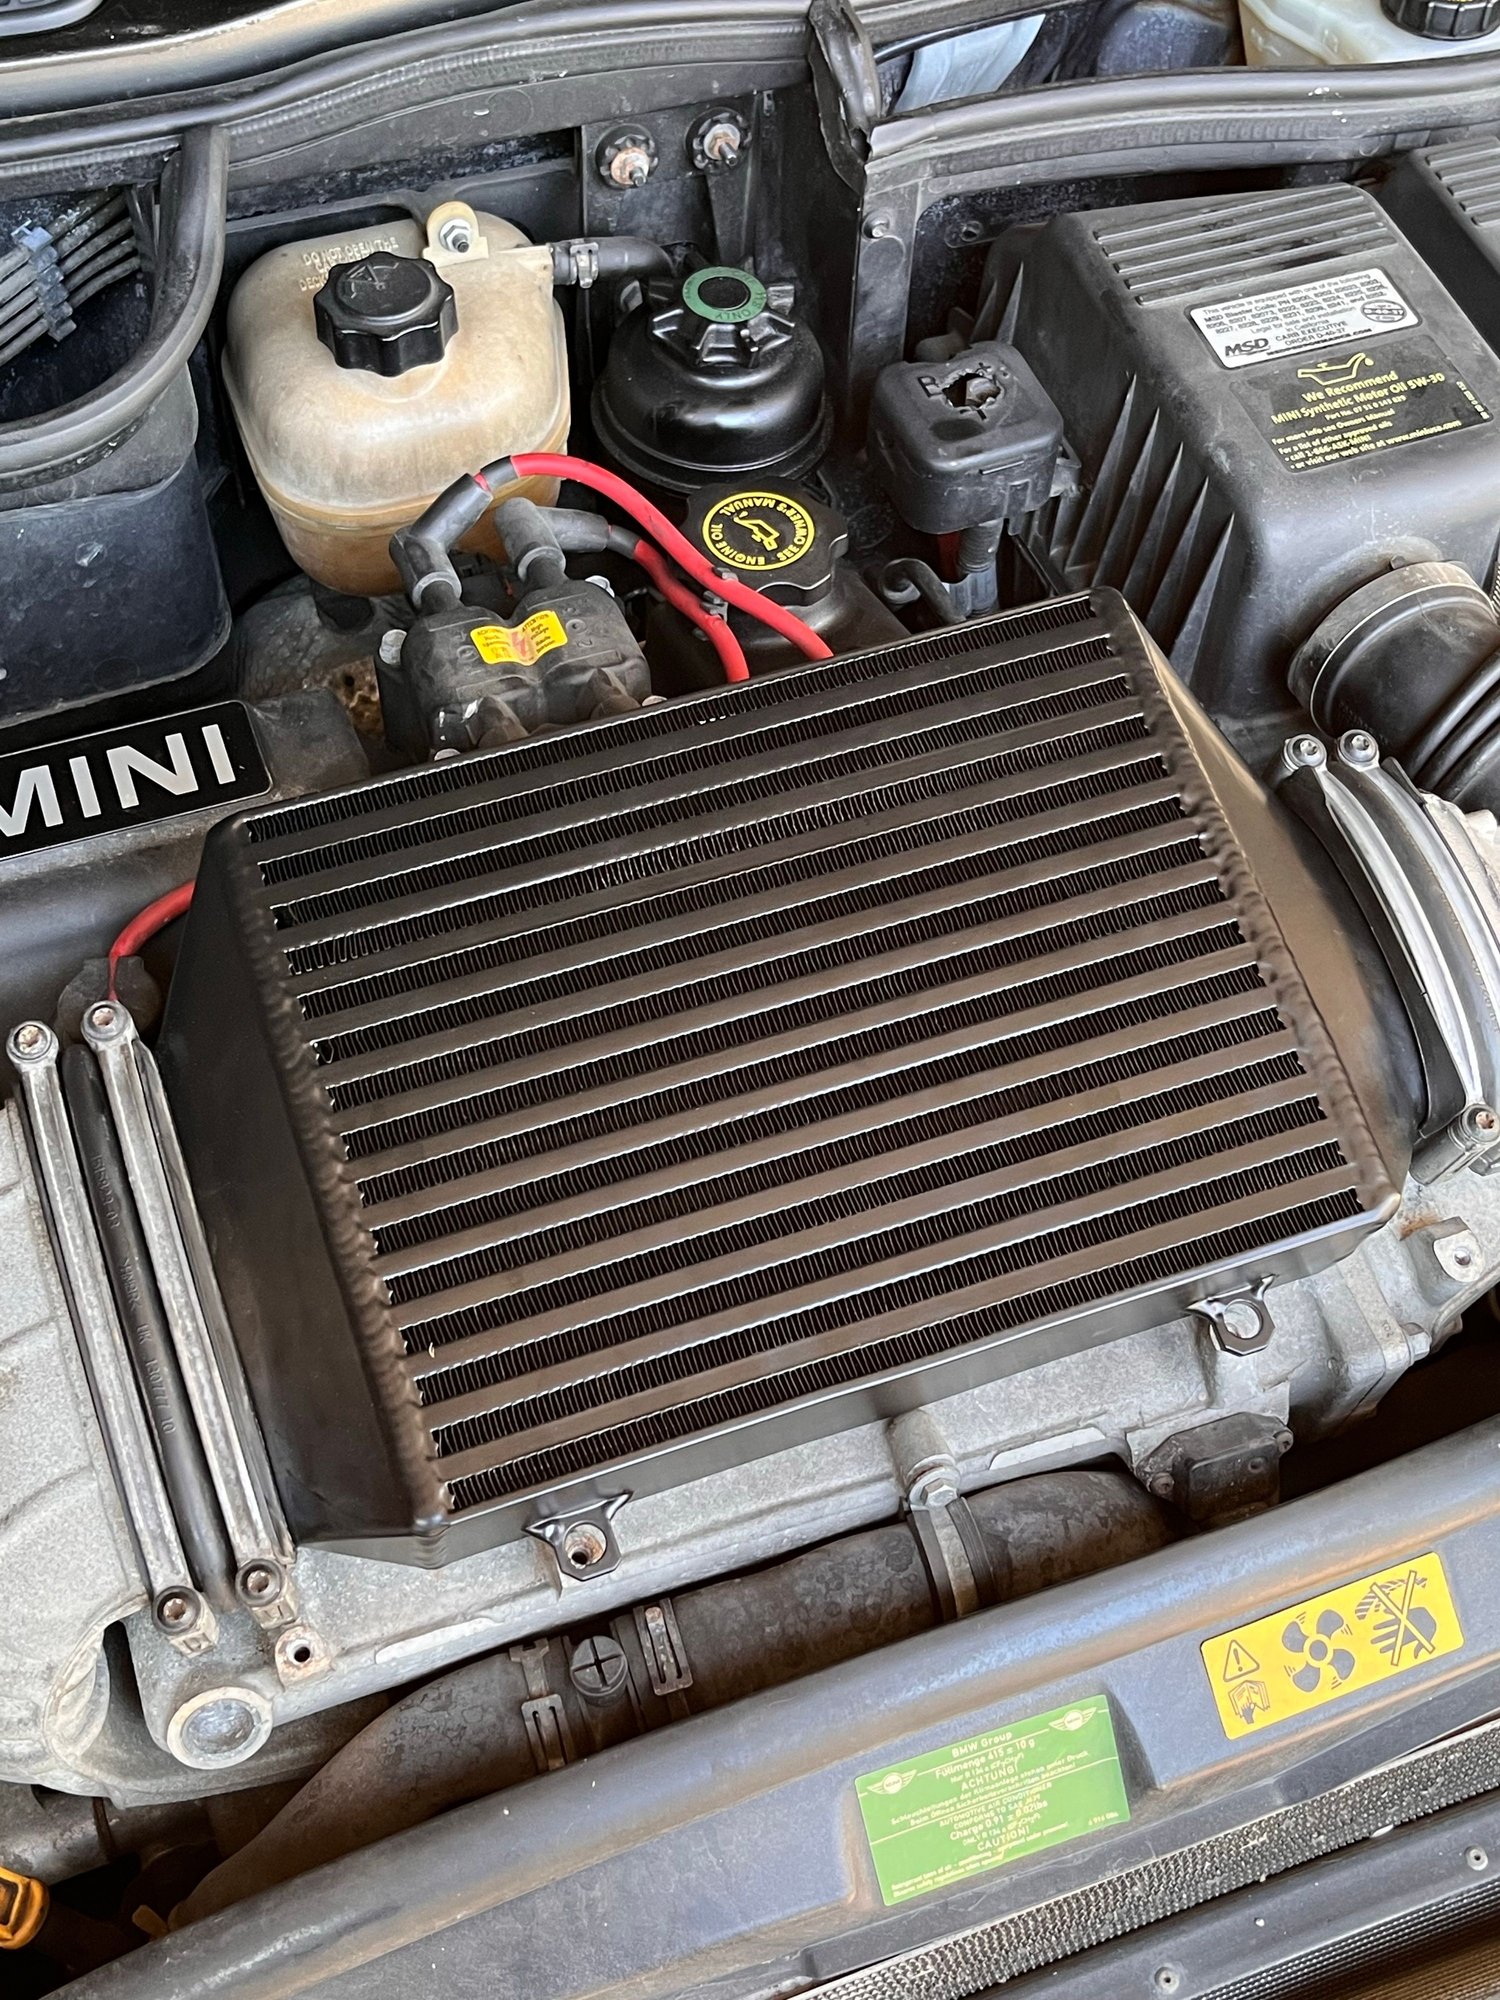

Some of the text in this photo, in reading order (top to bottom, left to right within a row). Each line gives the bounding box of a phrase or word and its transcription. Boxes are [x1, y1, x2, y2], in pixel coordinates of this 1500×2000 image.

[1283, 334, 1315, 346] ORDER
[1300, 320, 1348, 335] EXECUTIVE
[1220, 336, 1272, 356] MSD
[1270, 371, 1446, 425] MINI Synthetic Motor Oil 5W-30
[1301, 370, 1399, 403] We Recommend
[1271, 436, 1285, 446] For
[1285, 430, 1306, 442] more
[1305, 426, 1323, 436] info
[1335, 415, 1366, 428] Owners
[1364, 407, 1395, 420] Manual
[1277, 445, 1292, 455] For
[1319, 432, 1342, 444] other
[1341, 423, 1379, 439] approved
[1304, 455, 1324, 466] visit
[1323, 451, 1340, 461] our
[1338, 445, 1360, 457] web
[1358, 441, 1376, 452] site
[1384, 418, 1462, 445] www.miniusa.com
[1289, 451, 1305, 461] call
[719, 497, 776, 516] MANUAL
[711, 523, 766, 565] ENGINE OIL
[776, 544, 800, 561] SEE
[0, 723, 236, 837] MINI
[950, 1730, 1013, 1757] BMW Group
[934, 1754, 986, 1779] Füllmenge
[1015, 1738, 1027, 1751] 10
[1028, 1737, 1035, 1748] g
[938, 1806, 985, 1826] AUTOMOTIVE
[949, 1822, 984, 1841] Charge
